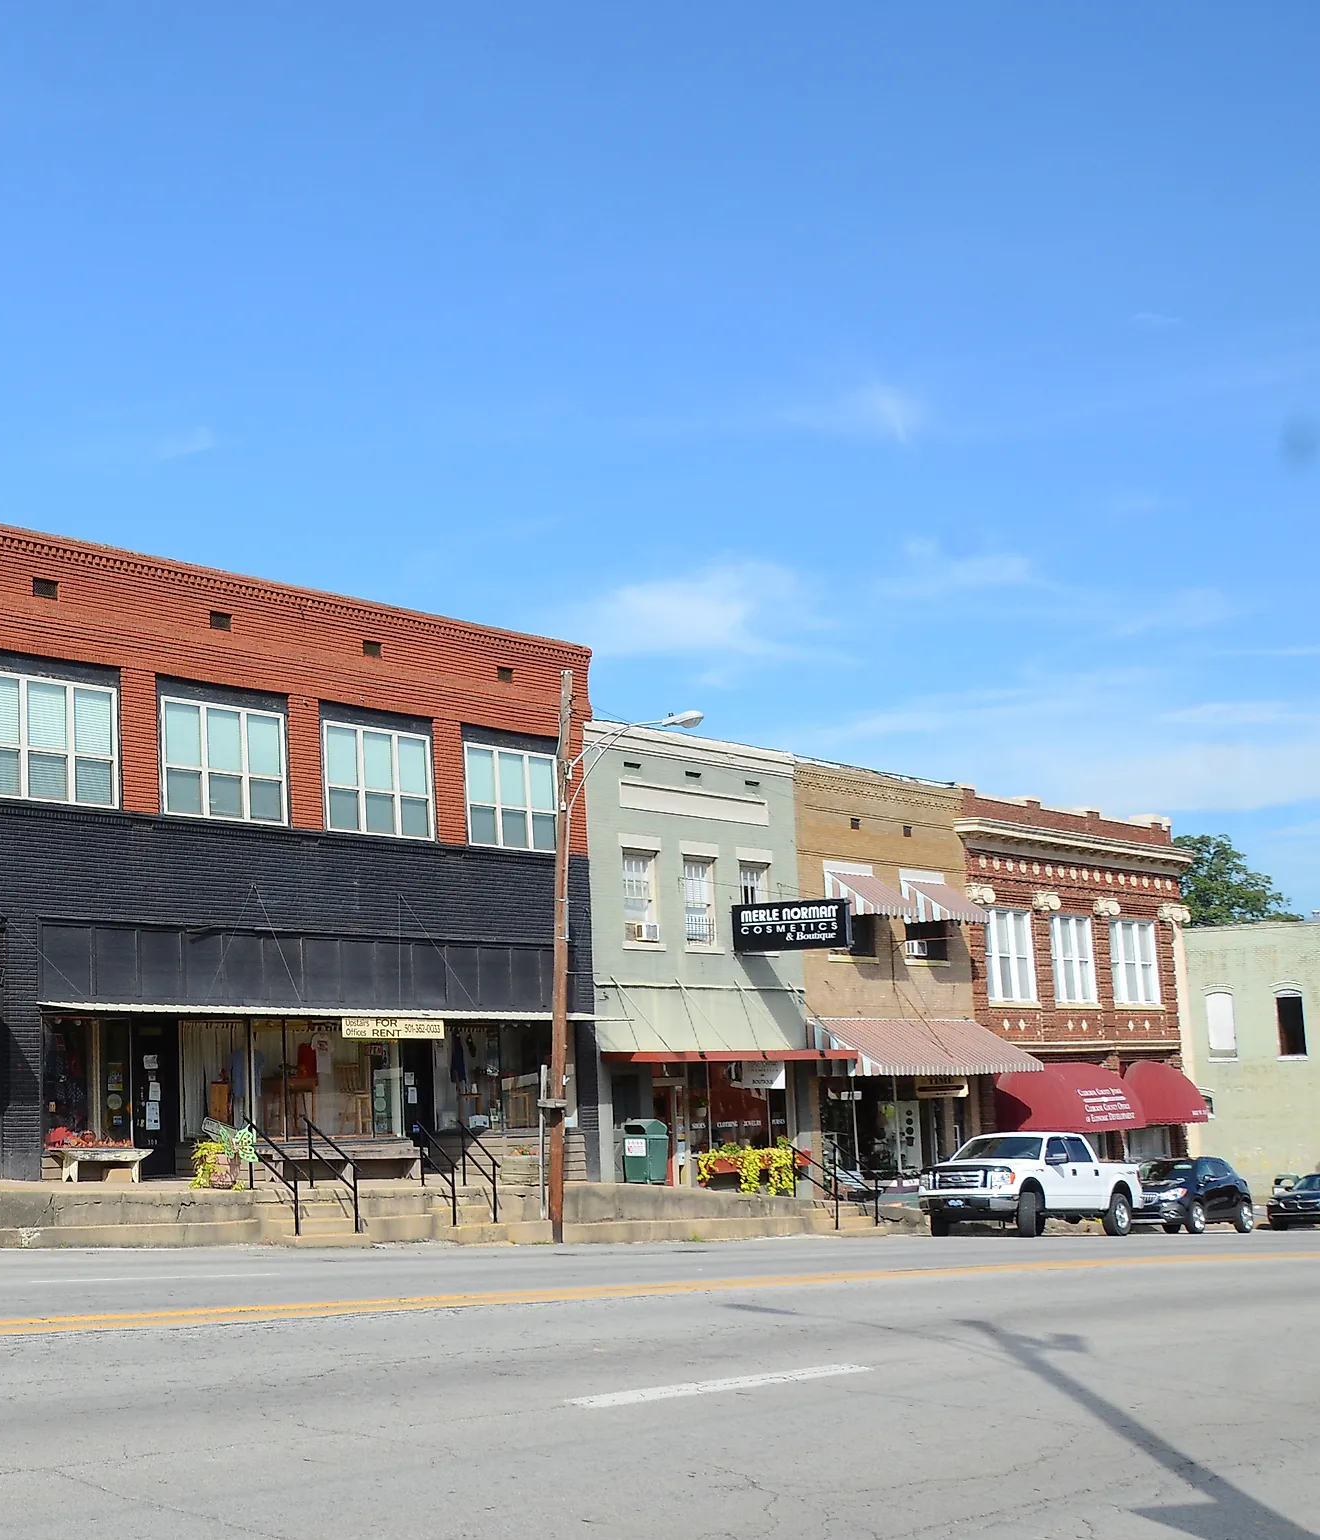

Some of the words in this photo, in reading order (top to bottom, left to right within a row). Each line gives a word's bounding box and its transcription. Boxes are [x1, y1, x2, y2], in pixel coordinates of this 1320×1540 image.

[741, 908, 779, 922] MERLE
[782, 905, 838, 920] NORMAN
[741, 922, 838, 935] COSMETICS
[785, 932, 794, 941] &
[796, 931, 837, 941] Boutique
[345, 1019, 370, 1028] Upstairs
[375, 1019, 398, 1027] FOR
[345, 1028, 367, 1037] Offices
[372, 1029, 402, 1037] RENT
